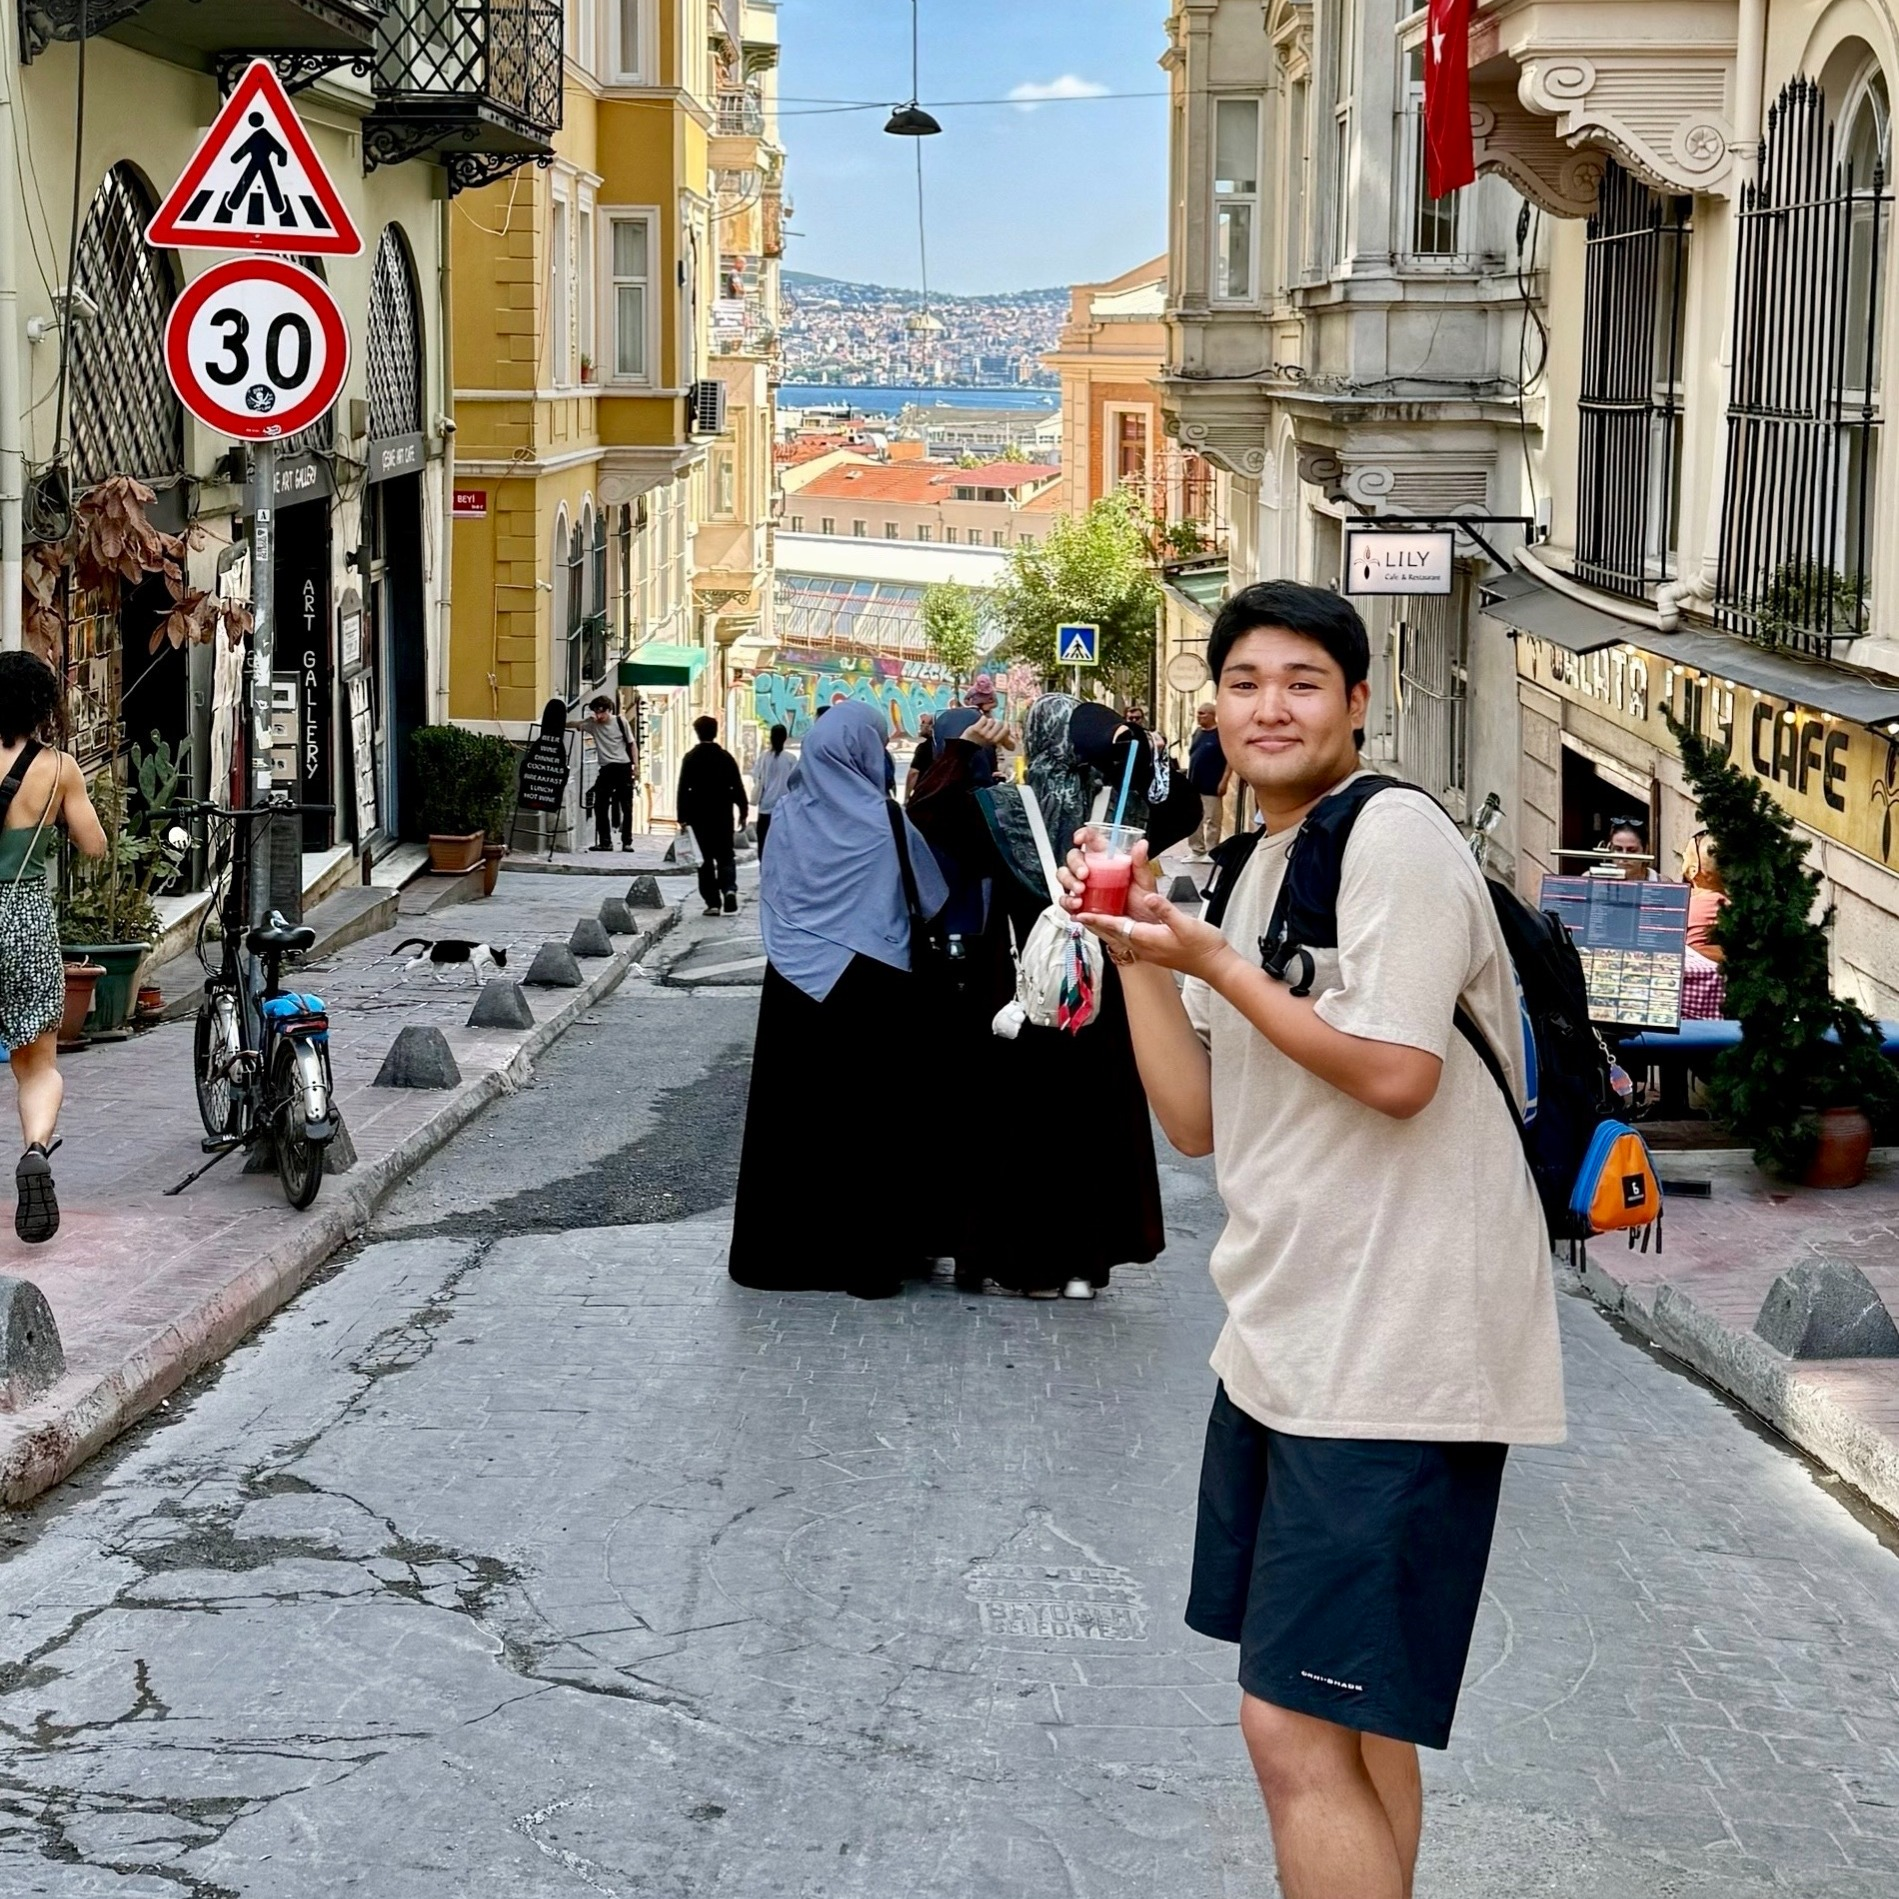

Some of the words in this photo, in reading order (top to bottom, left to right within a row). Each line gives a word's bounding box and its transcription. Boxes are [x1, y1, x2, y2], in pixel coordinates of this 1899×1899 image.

[205, 307, 311, 390] 30
[281, 470, 294, 492] ART
[295, 464, 317, 490] GALLERY
[1386, 551, 1430, 567] LILY
[303, 579, 316, 631] ART
[303, 650, 318, 779] GALLERY
[541, 735, 561, 743] BEER
[540, 745, 558, 754] WINE
[534, 754, 561, 764] DINNER
[1752, 701, 1849, 812] CAFE
[527, 762, 565, 774] COCKTAILS
[523, 773, 563, 785] BREAKFAST
[530, 784, 554, 794] LUNCH
[523, 792, 538, 800] HOT
[539, 795, 556, 803] WINE
